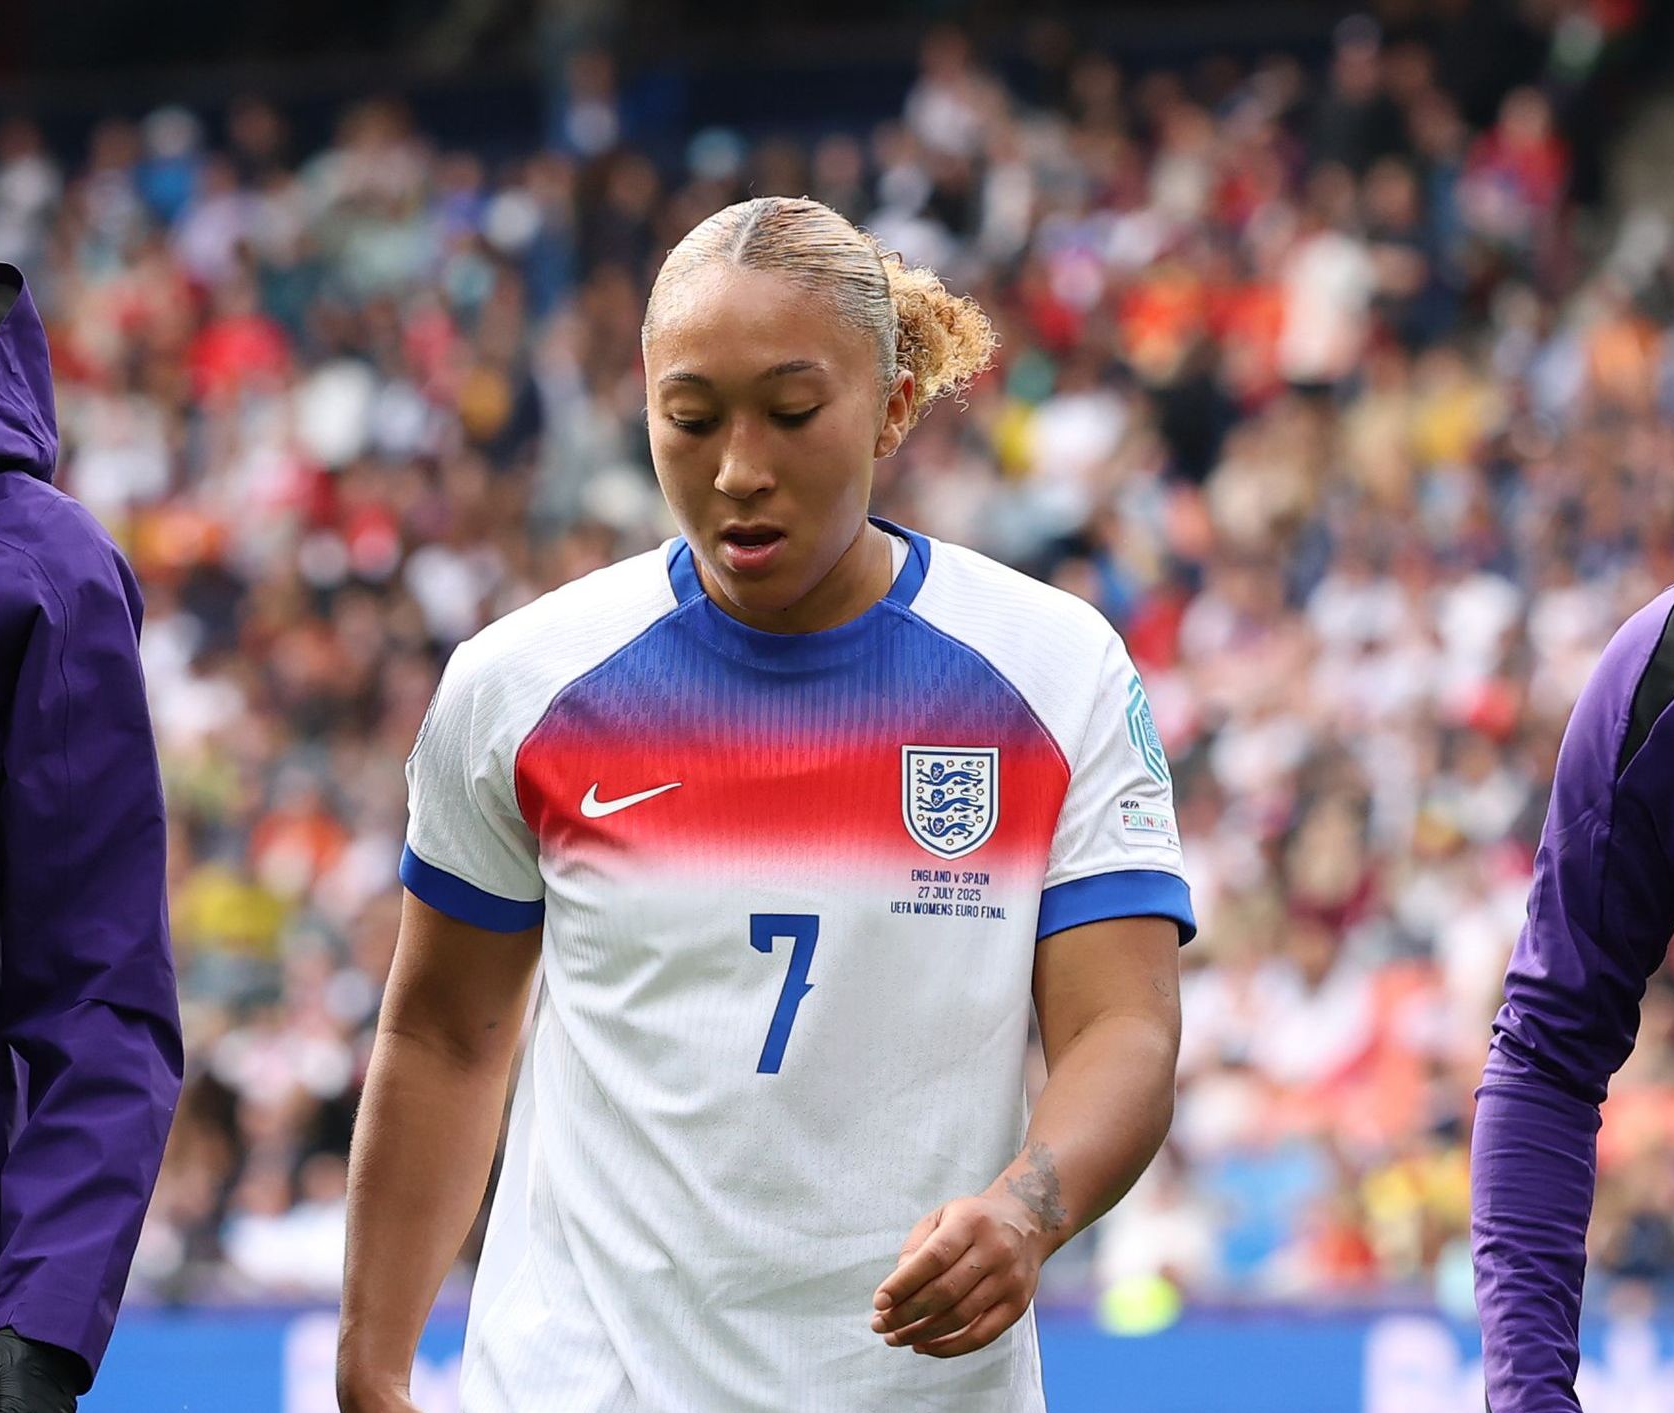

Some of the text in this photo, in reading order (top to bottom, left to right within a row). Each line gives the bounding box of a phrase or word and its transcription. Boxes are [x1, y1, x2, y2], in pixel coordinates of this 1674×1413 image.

[1120, 800, 1140, 809] UEFA
[911, 869, 990, 885] ENGLAND v SPAIN
[918, 886, 981, 901] 27 JULY 2025
[891, 901, 1007, 920] UEFA WOMENS EURO FINAL
[750, 913, 820, 1074] 7
